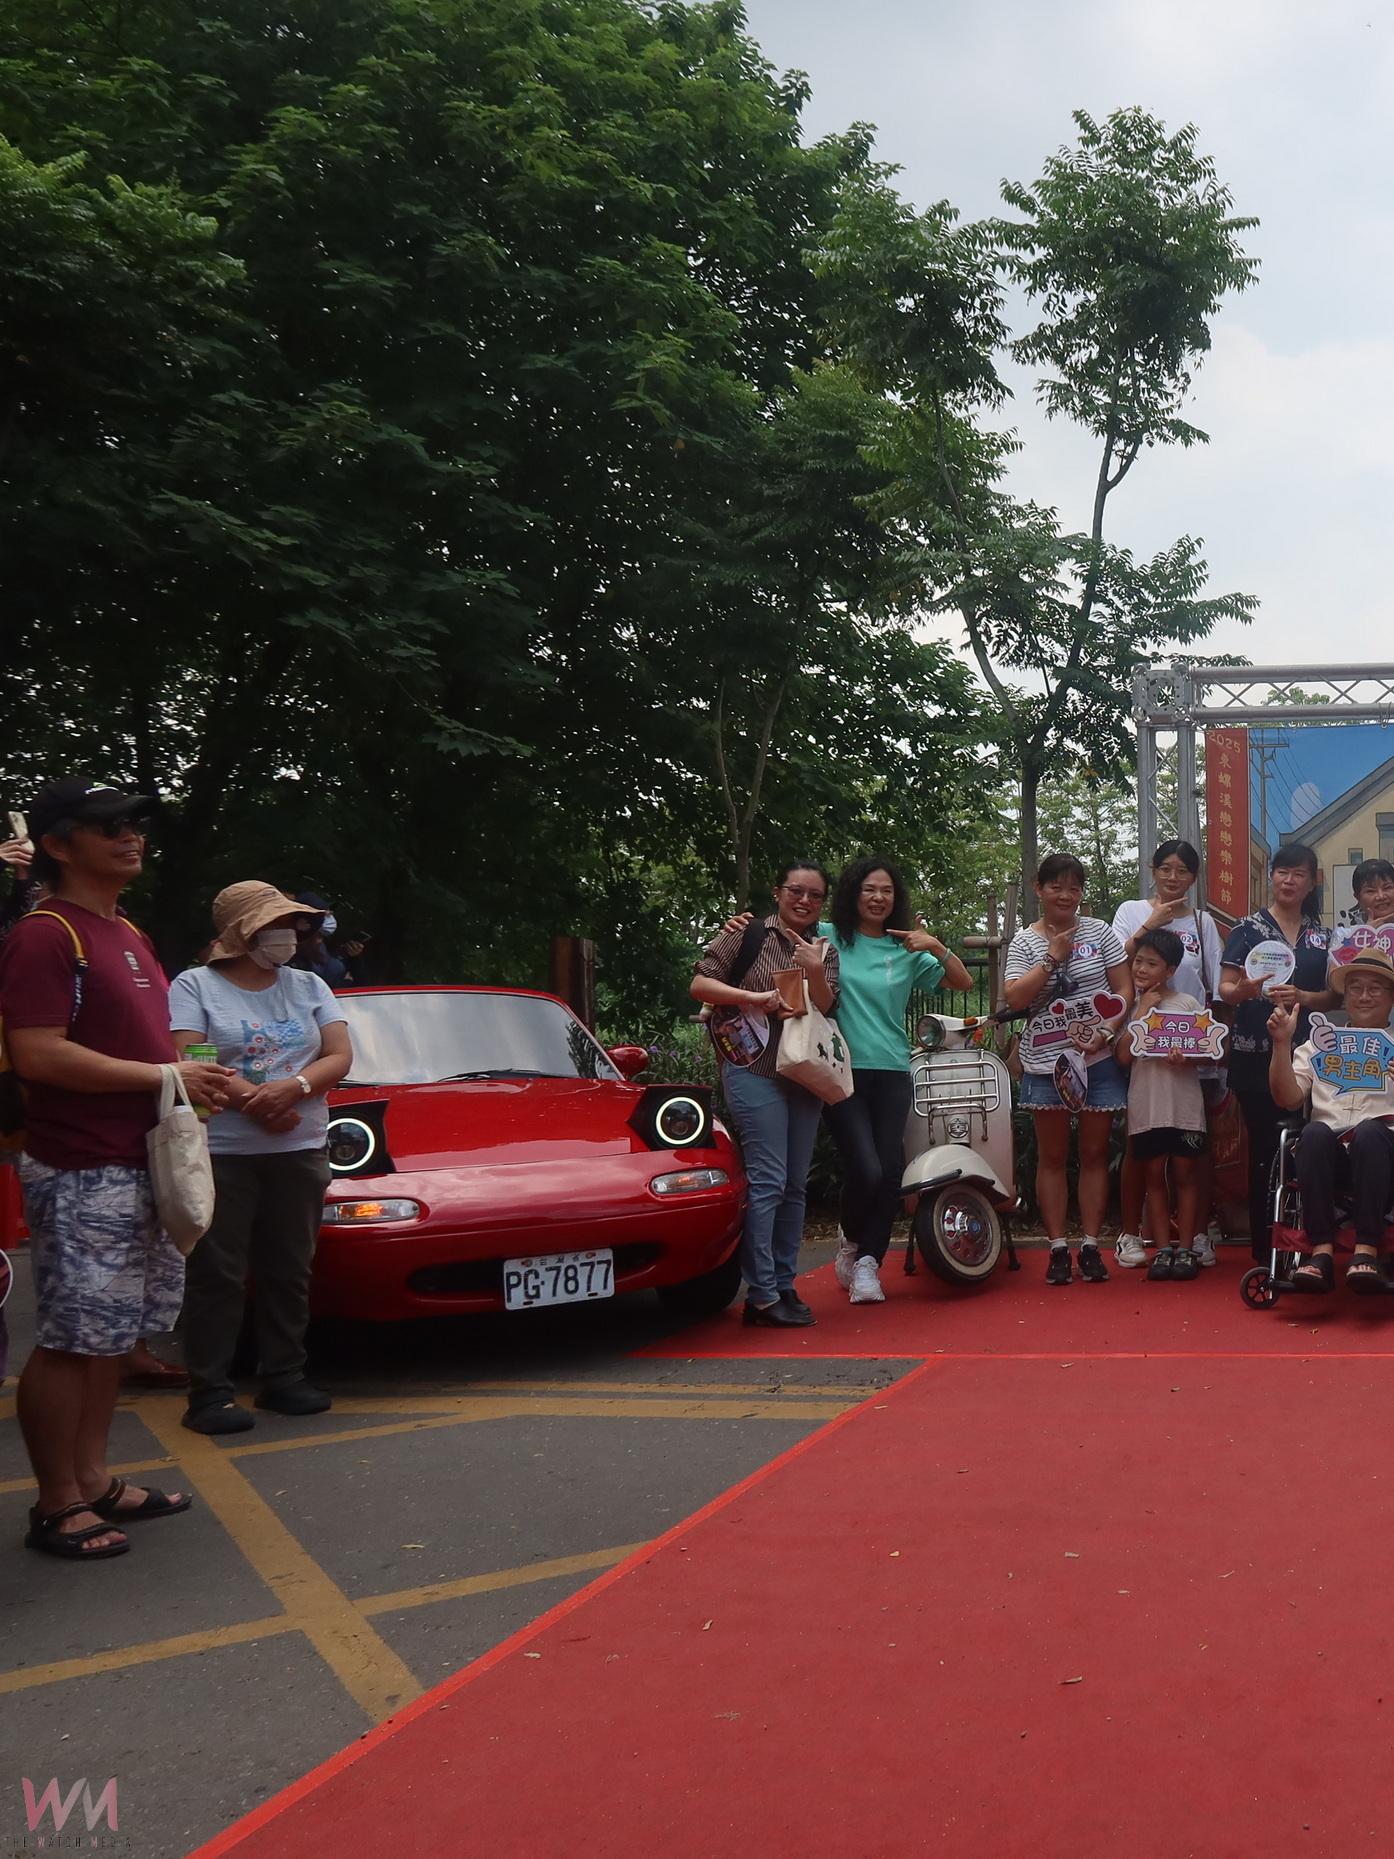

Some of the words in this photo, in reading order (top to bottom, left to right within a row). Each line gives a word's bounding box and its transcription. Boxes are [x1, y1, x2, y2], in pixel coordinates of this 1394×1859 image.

[1208, 729, 1241, 753] 2025
[1181, 935, 1192, 943] 02
[1352, 930, 1391, 952] 女神
[1080, 946, 1091, 954] 01
[1032, 1001, 1094, 1032] 今日我最美
[1165, 1021, 1190, 1033] 今日
[1157, 1036, 1196, 1049] 我最棒
